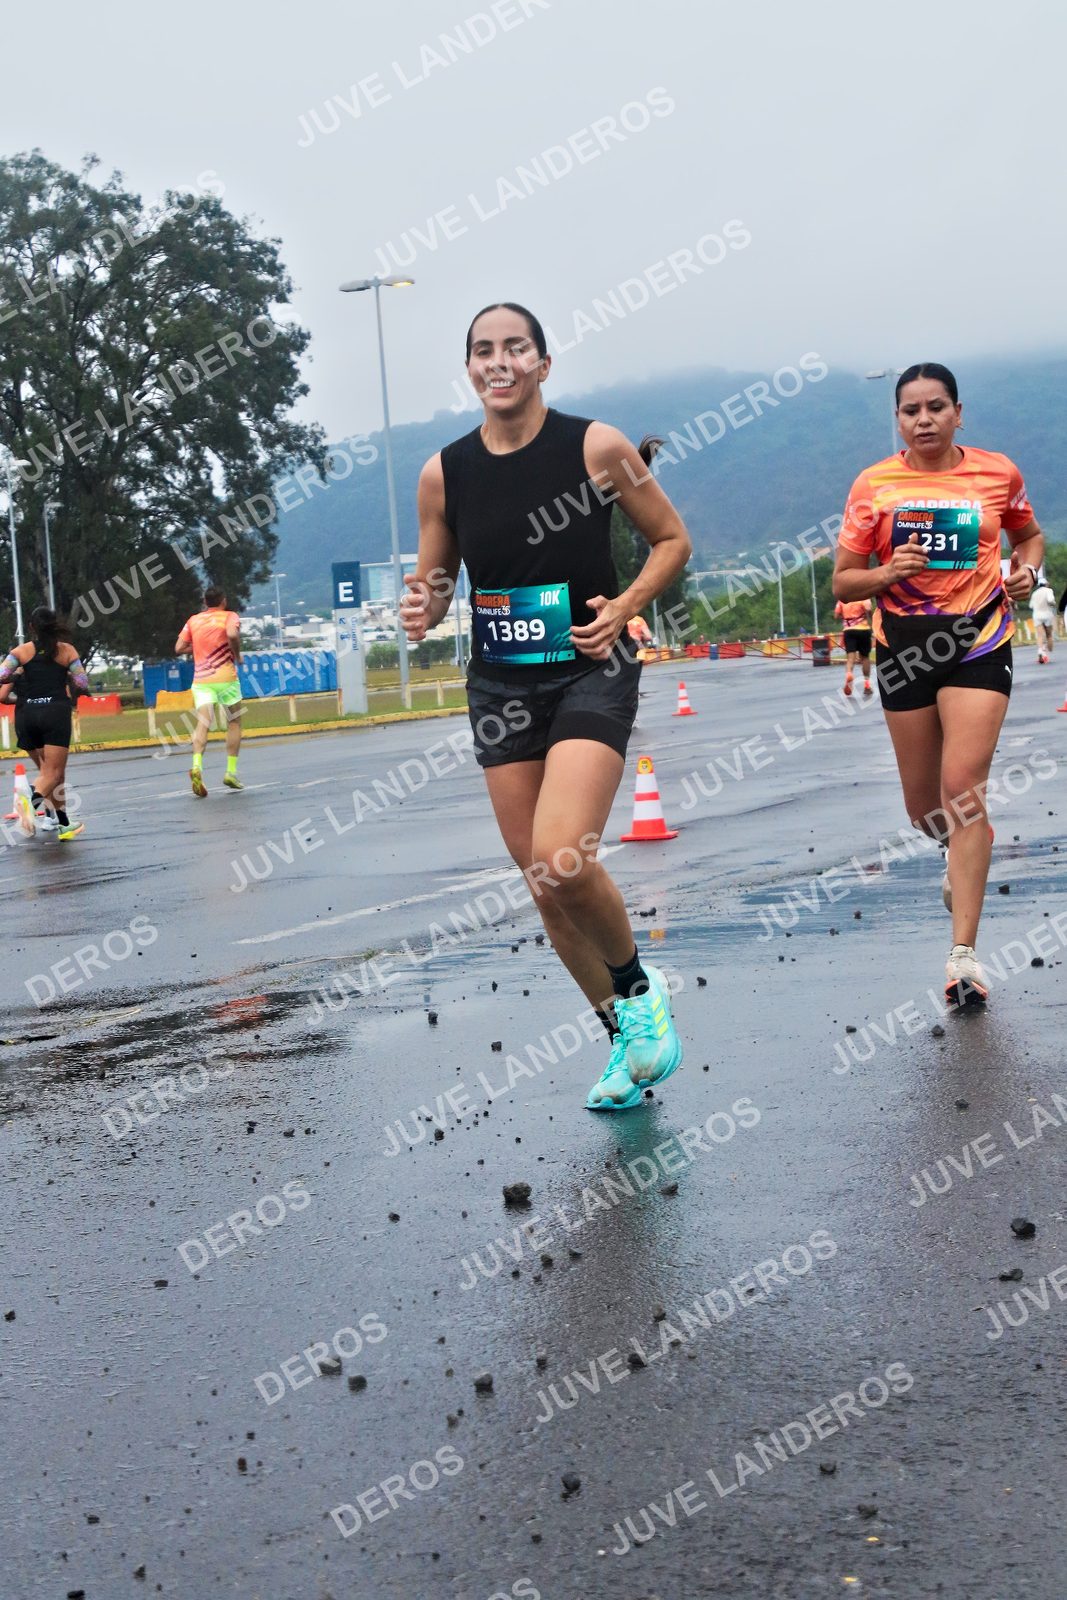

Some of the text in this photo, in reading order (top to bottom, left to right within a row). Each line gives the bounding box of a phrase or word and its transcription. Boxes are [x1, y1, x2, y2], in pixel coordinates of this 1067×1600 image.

[898, 511, 934, 521] CARRERA
[957, 512, 972, 525] 10K
[908, 533, 958, 551] 231
[338, 581, 354, 602] E
[539, 590, 561, 606] 10K
[487, 619, 545, 642] 1389
